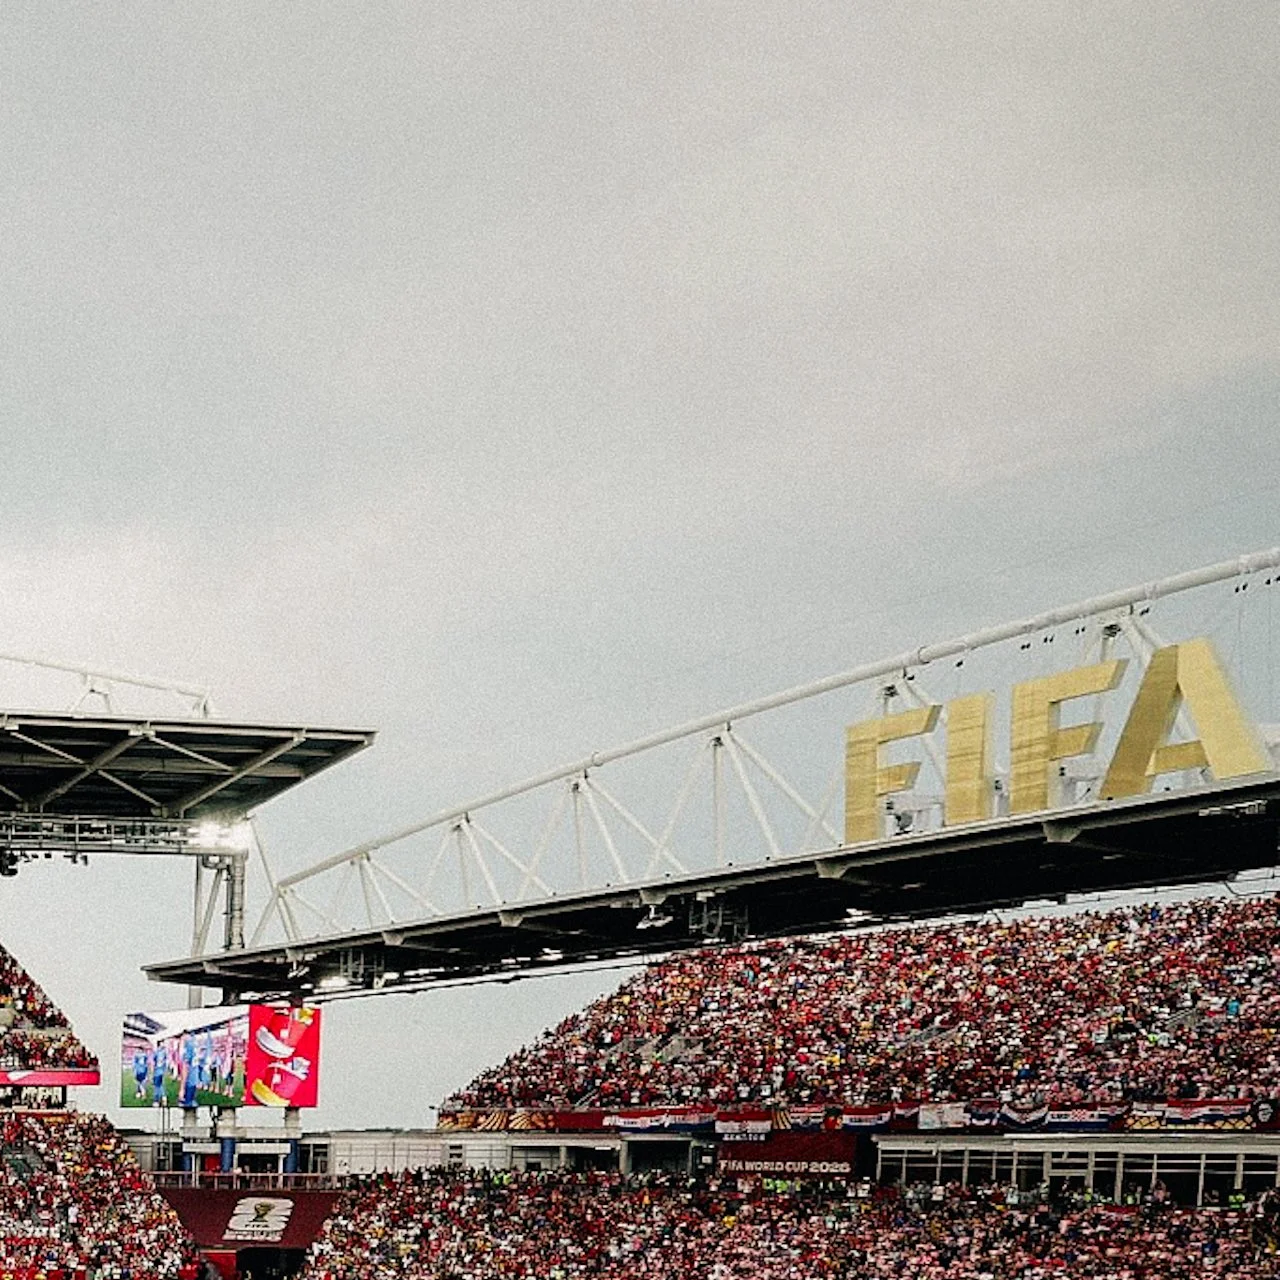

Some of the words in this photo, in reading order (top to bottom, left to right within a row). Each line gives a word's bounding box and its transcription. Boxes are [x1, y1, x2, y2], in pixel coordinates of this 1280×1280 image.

[845, 637, 1274, 843] FIFA
[719, 1160, 744, 1172] FIFA
[745, 1161, 784, 1172] WORLD
[785, 1161, 809, 1173] CUP
[809, 1161, 853, 1174] 2026
